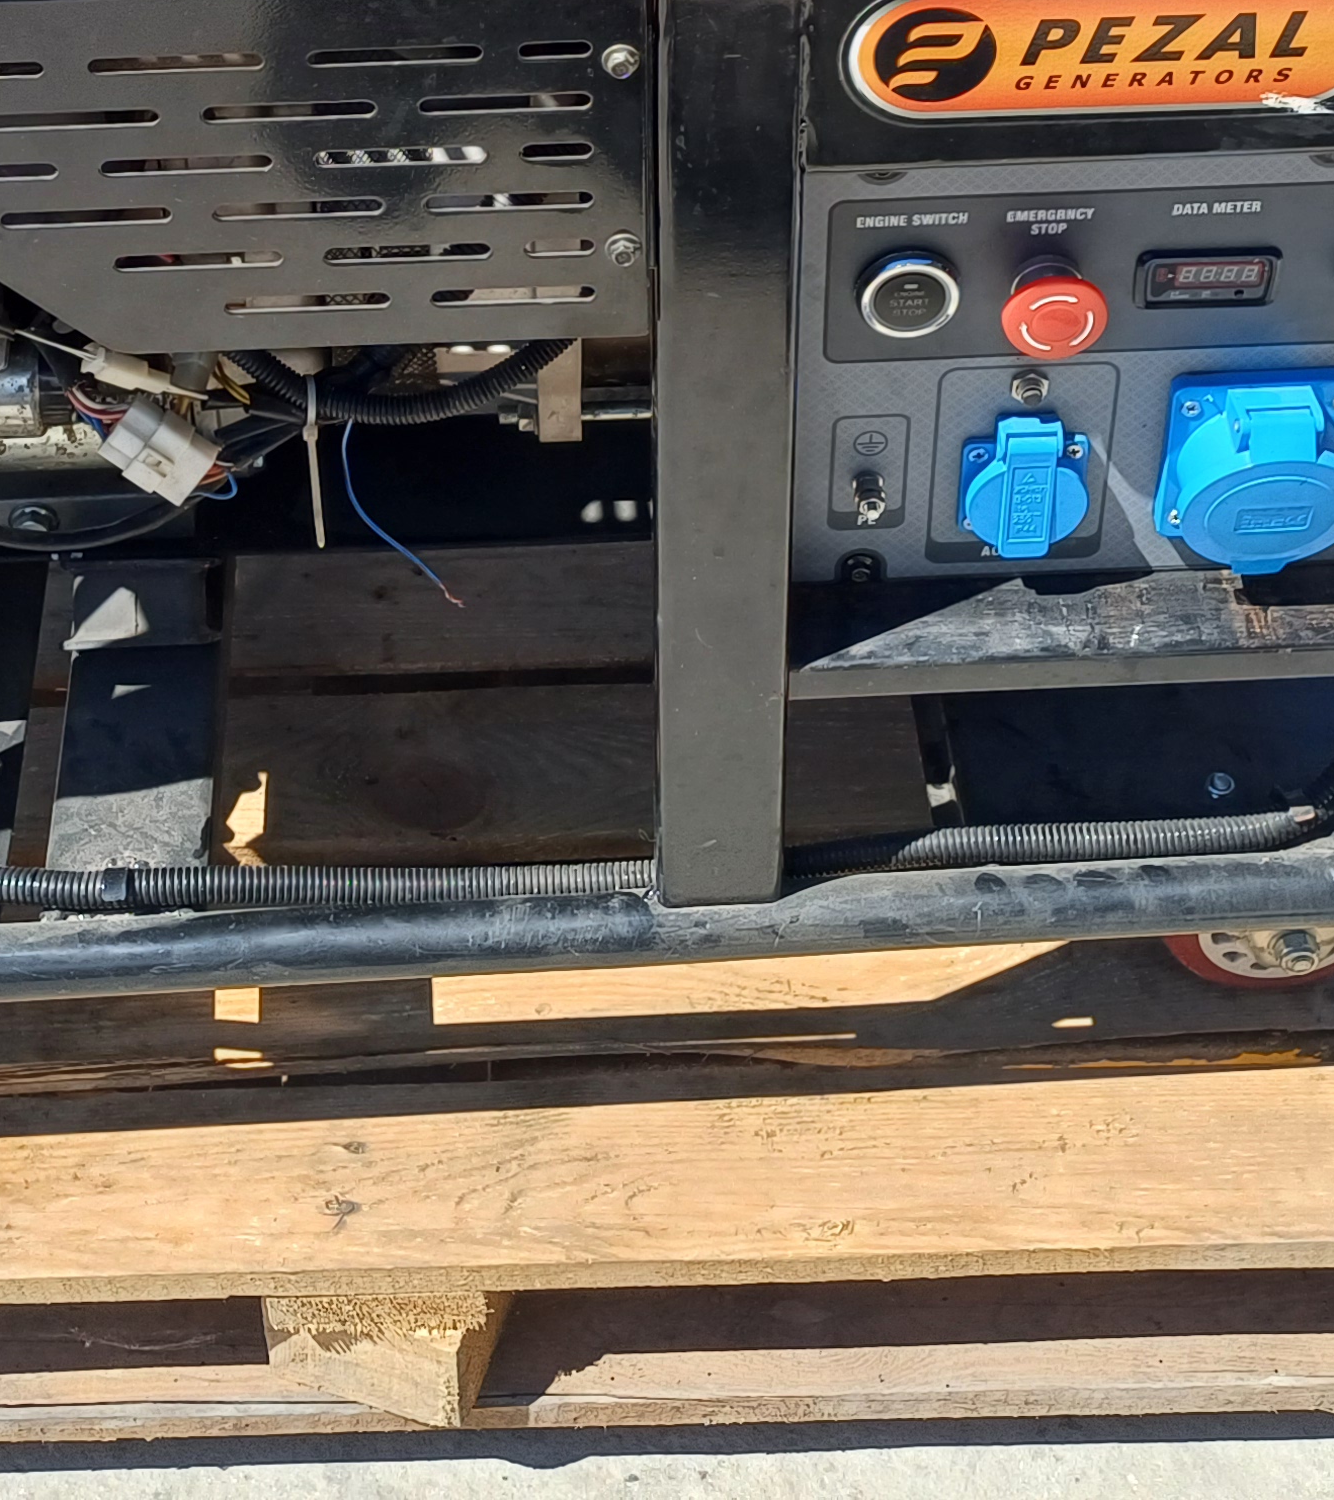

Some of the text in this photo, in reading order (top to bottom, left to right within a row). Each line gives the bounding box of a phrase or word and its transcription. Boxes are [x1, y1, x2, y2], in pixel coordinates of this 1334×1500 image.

[1019, 10, 1309, 67] PEZAL
[1015, 67, 1292, 91] GENERATORS
[1171, 200, 1262, 216] DATA METER
[856, 212, 969, 228] ENGINE SWITCH
[1030, 223, 1067, 236] STOP
[889, 298, 929, 307] START
[892, 308, 927, 317] STOP
